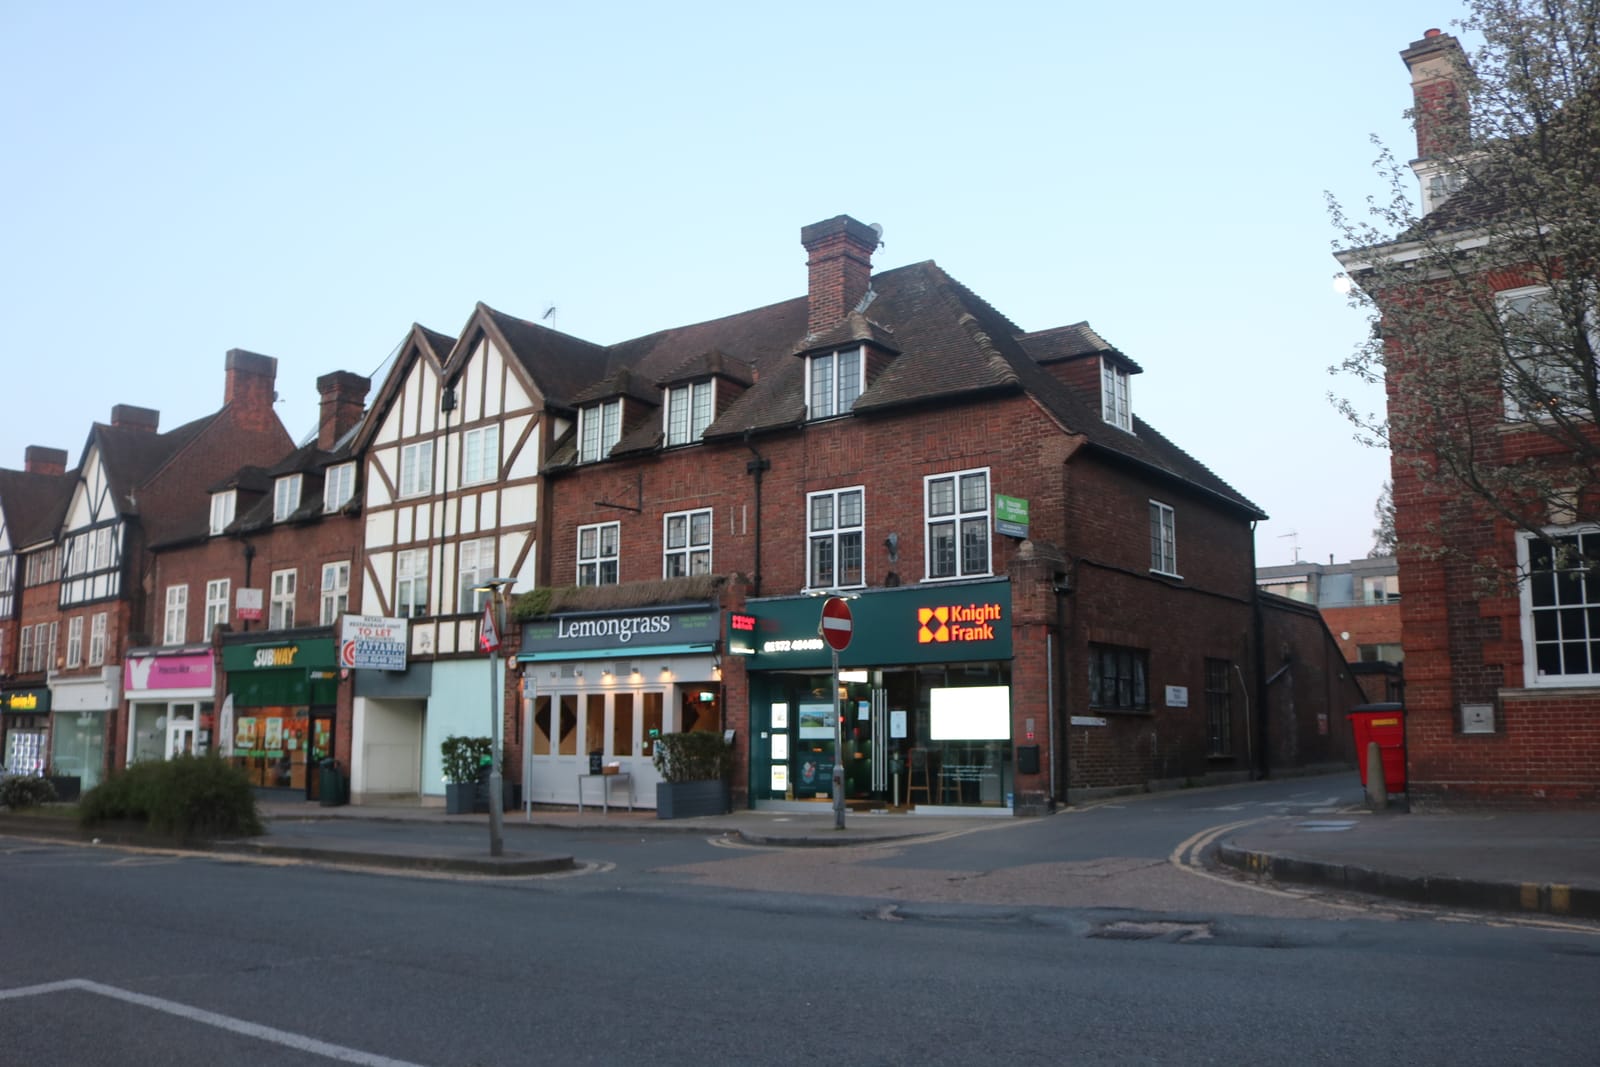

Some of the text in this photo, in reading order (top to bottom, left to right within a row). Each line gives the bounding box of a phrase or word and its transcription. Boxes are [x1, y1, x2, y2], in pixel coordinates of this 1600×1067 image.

[951, 603, 1001, 625] Knight
[358, 627, 391, 637] TO LET
[558, 615, 670, 642] Lemongrass
[951, 623, 994, 641] Frank
[253, 646, 299, 668] SUBWAY
